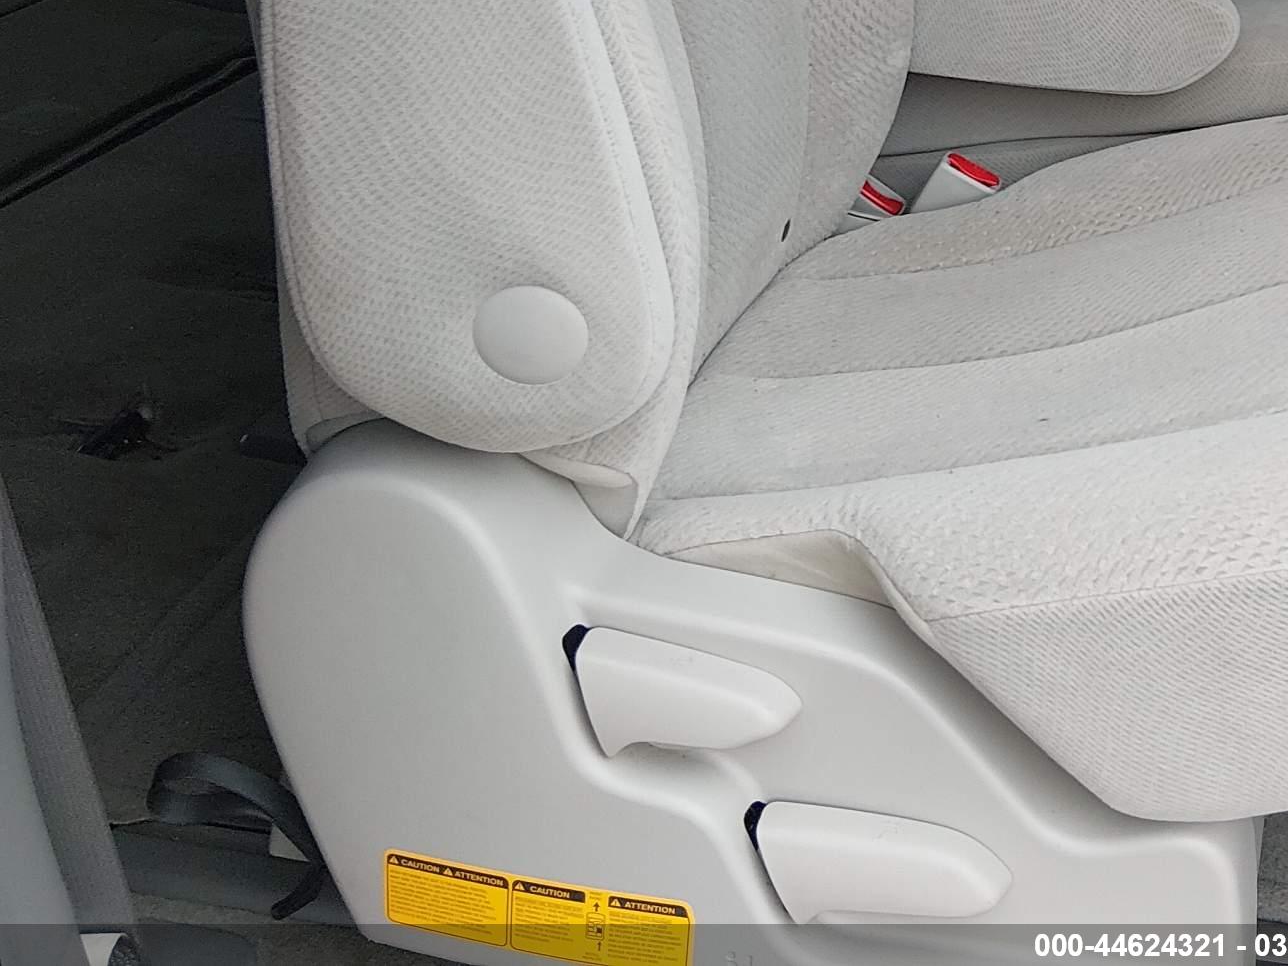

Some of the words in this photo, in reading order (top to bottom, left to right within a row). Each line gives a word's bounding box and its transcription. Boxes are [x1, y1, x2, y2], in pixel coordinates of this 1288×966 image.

[401, 858, 440, 873] CAUTION
[454, 871, 504, 886] ATTENTION
[529, 885, 570, 899] CAUTION
[624, 901, 676, 915] ATTENTION
